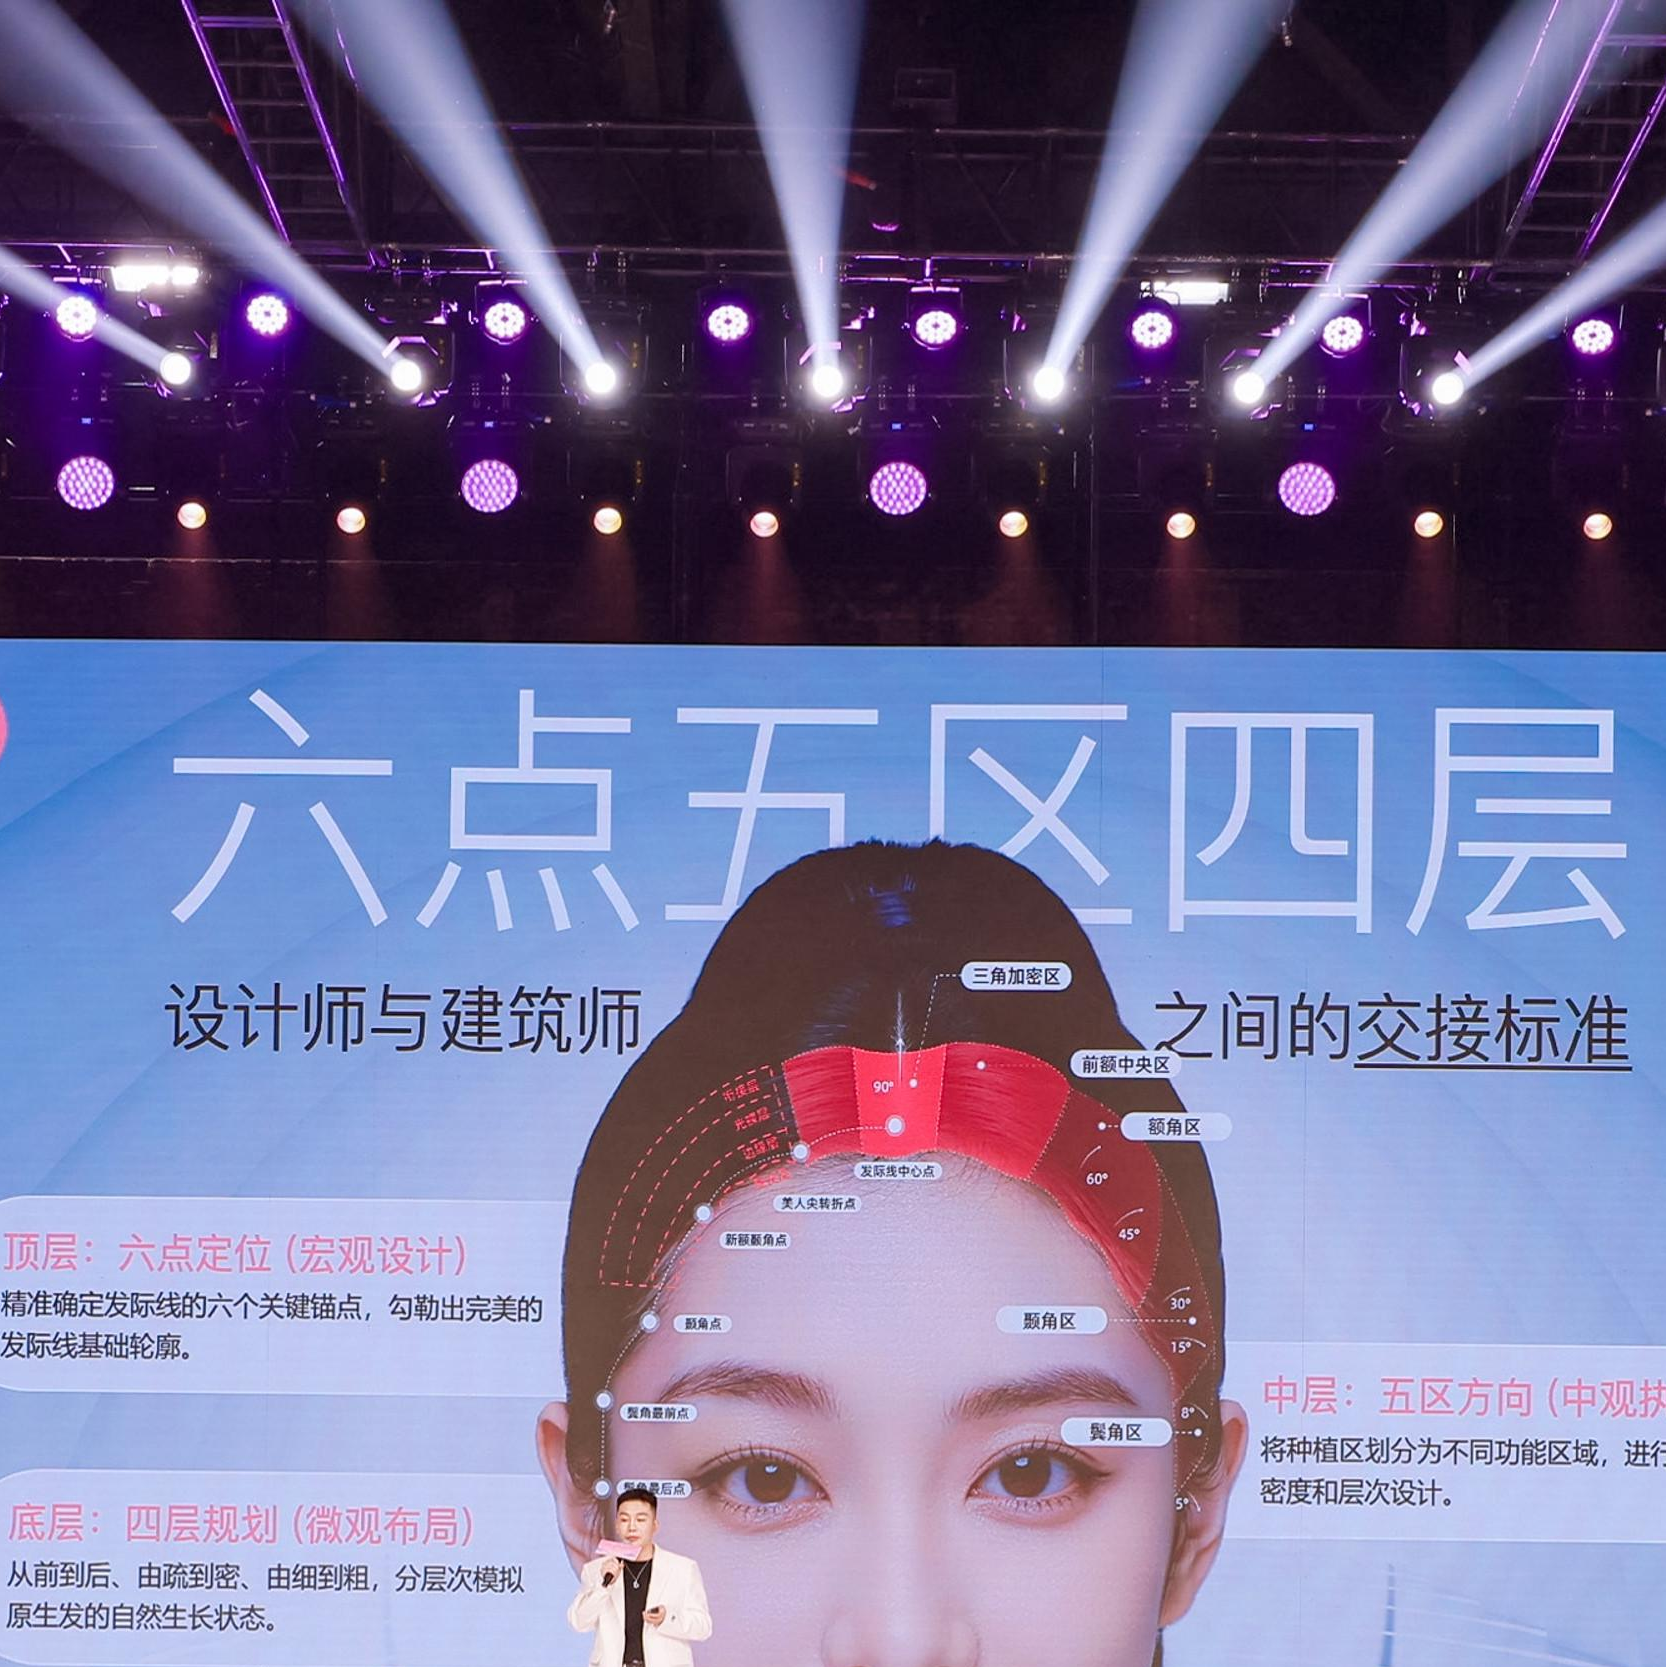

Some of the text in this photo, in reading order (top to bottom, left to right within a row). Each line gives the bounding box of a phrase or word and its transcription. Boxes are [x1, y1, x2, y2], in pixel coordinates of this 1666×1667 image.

[170, 688, 1629, 940] 六点五区四层
[972, 966, 1061, 986] 三角加密区
[164, 981, 1630, 1066] 设计师与建筑师 之间的交接标准
[1081, 1054, 1171, 1074] 前额中央区
[1147, 1117, 1202, 1137] 额角区
[859, 1164, 936, 1180] 发际线中心点
[781, 1197, 857, 1211] 美人尖转折点
[0, 1290, 544, 1324] 精准确定发际线的六个关键锚点，勾勒出完美的
[0, 1332, 193, 1361] 发际线基础轮廓。
[1089, 1423, 1143, 1442] 鬓角区
[1259, 1478, 1454, 1508] 密度和层次设计。
[6, 1560, 525, 1595] 从前到后、由疏到密、由细到粗，分层次模拟
[5, 1602, 279, 1633] 原生发的自然生长状态。
